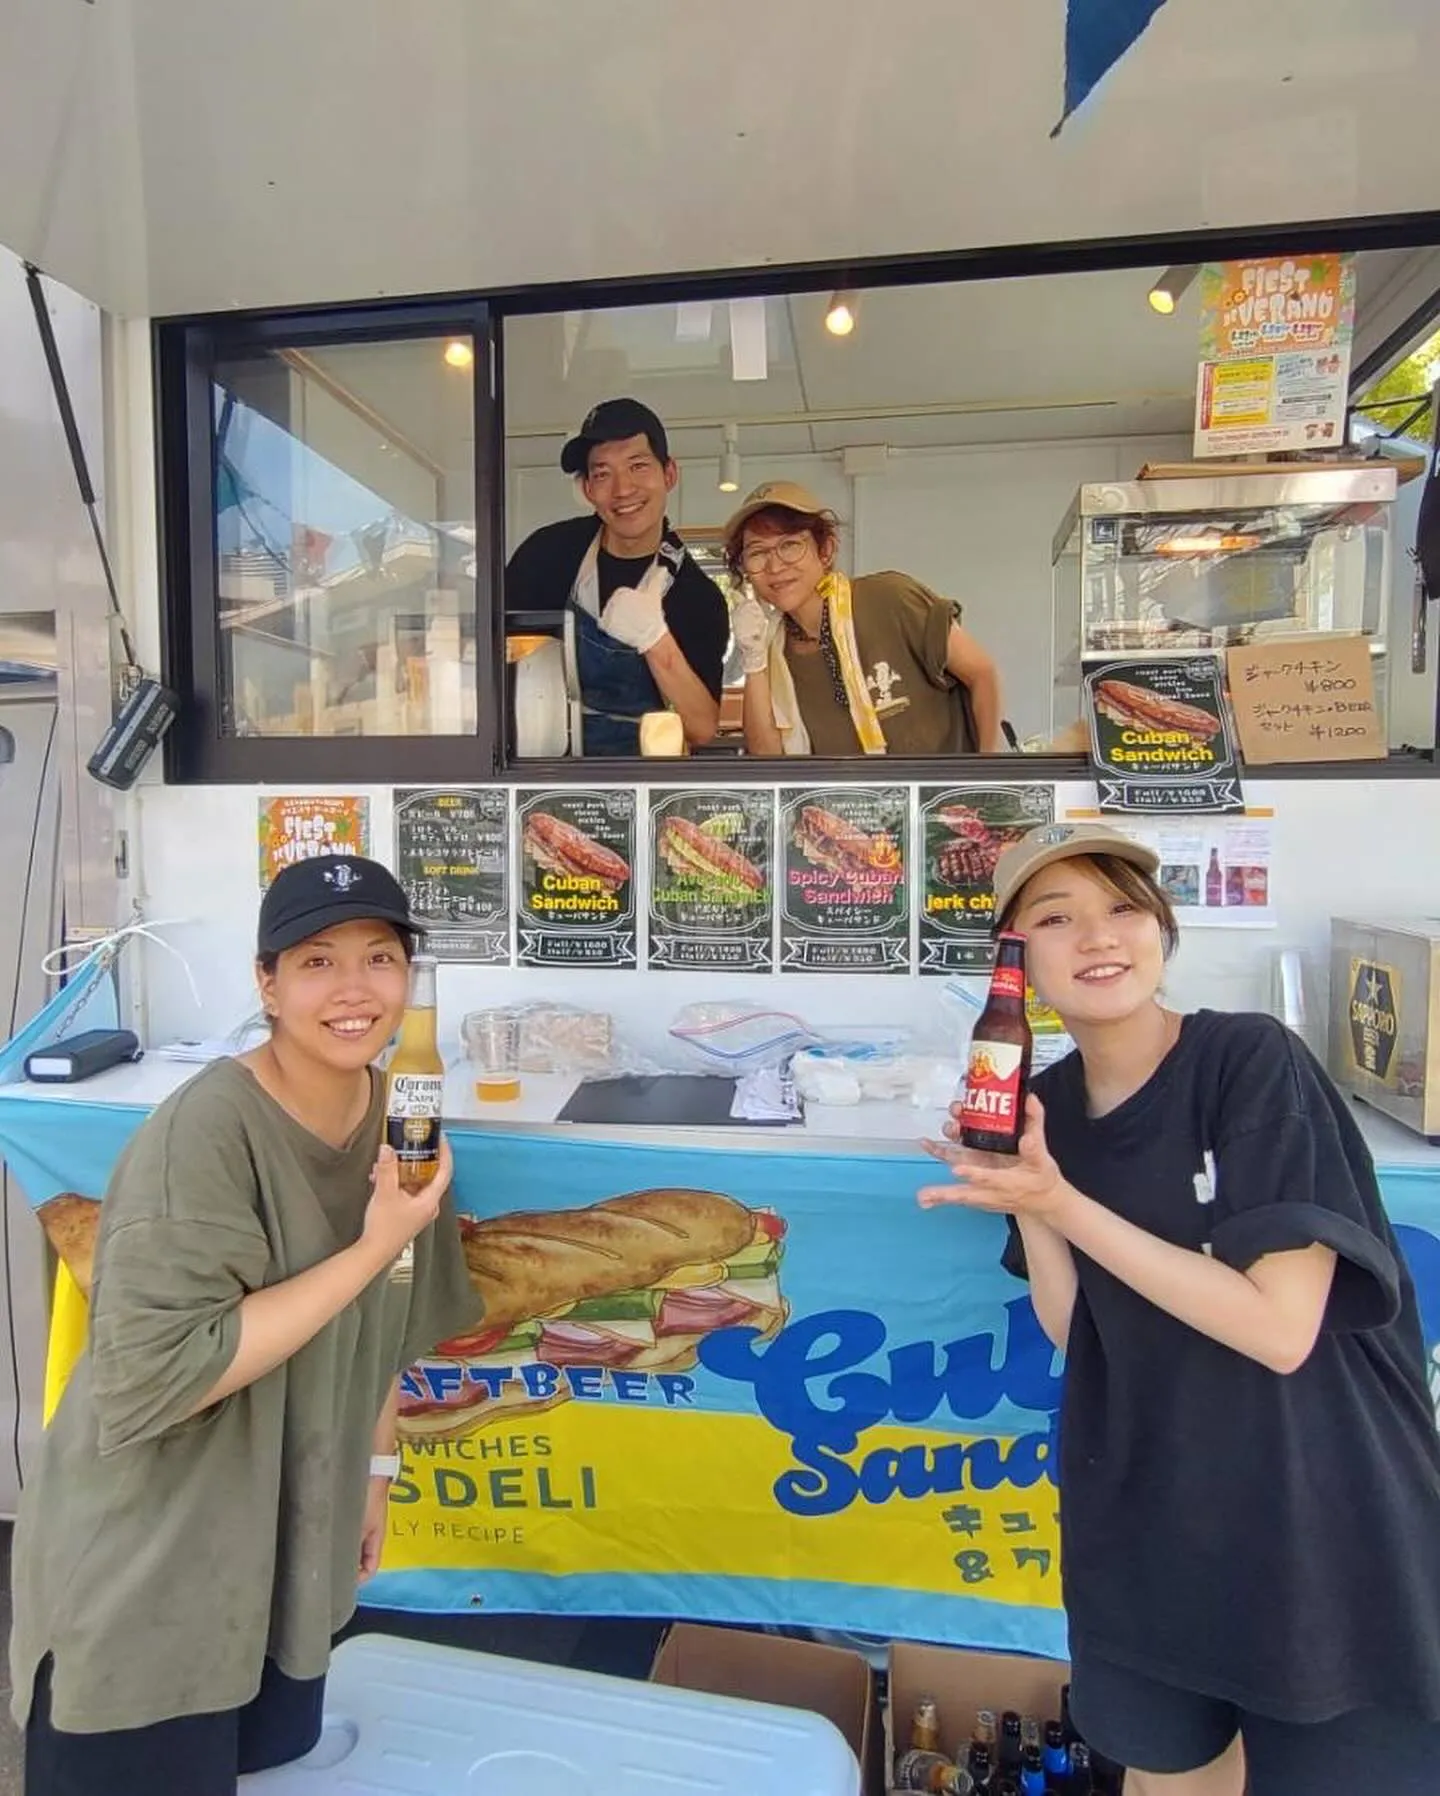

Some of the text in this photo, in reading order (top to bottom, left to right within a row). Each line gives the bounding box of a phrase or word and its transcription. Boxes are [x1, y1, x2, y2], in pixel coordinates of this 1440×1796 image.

[1121, 730, 1190, 745] Cuban
[1111, 747, 1214, 762] Sandwich
[542, 875, 601, 891] Cuban
[789, 870, 905, 888] Spicy Cuban
[532, 894, 618, 910] Sandwich
[804, 889, 893, 905] Sandwich
[927, 894, 965, 912] jerk
[962, 1088, 1013, 1115] CATE
[399, 1435, 553, 1461] WICHES
[773, 1411, 1061, 1516] Sand
[942, 1504, 1061, 1539] キュ
[433, 1522, 525, 1544] RECIPE
